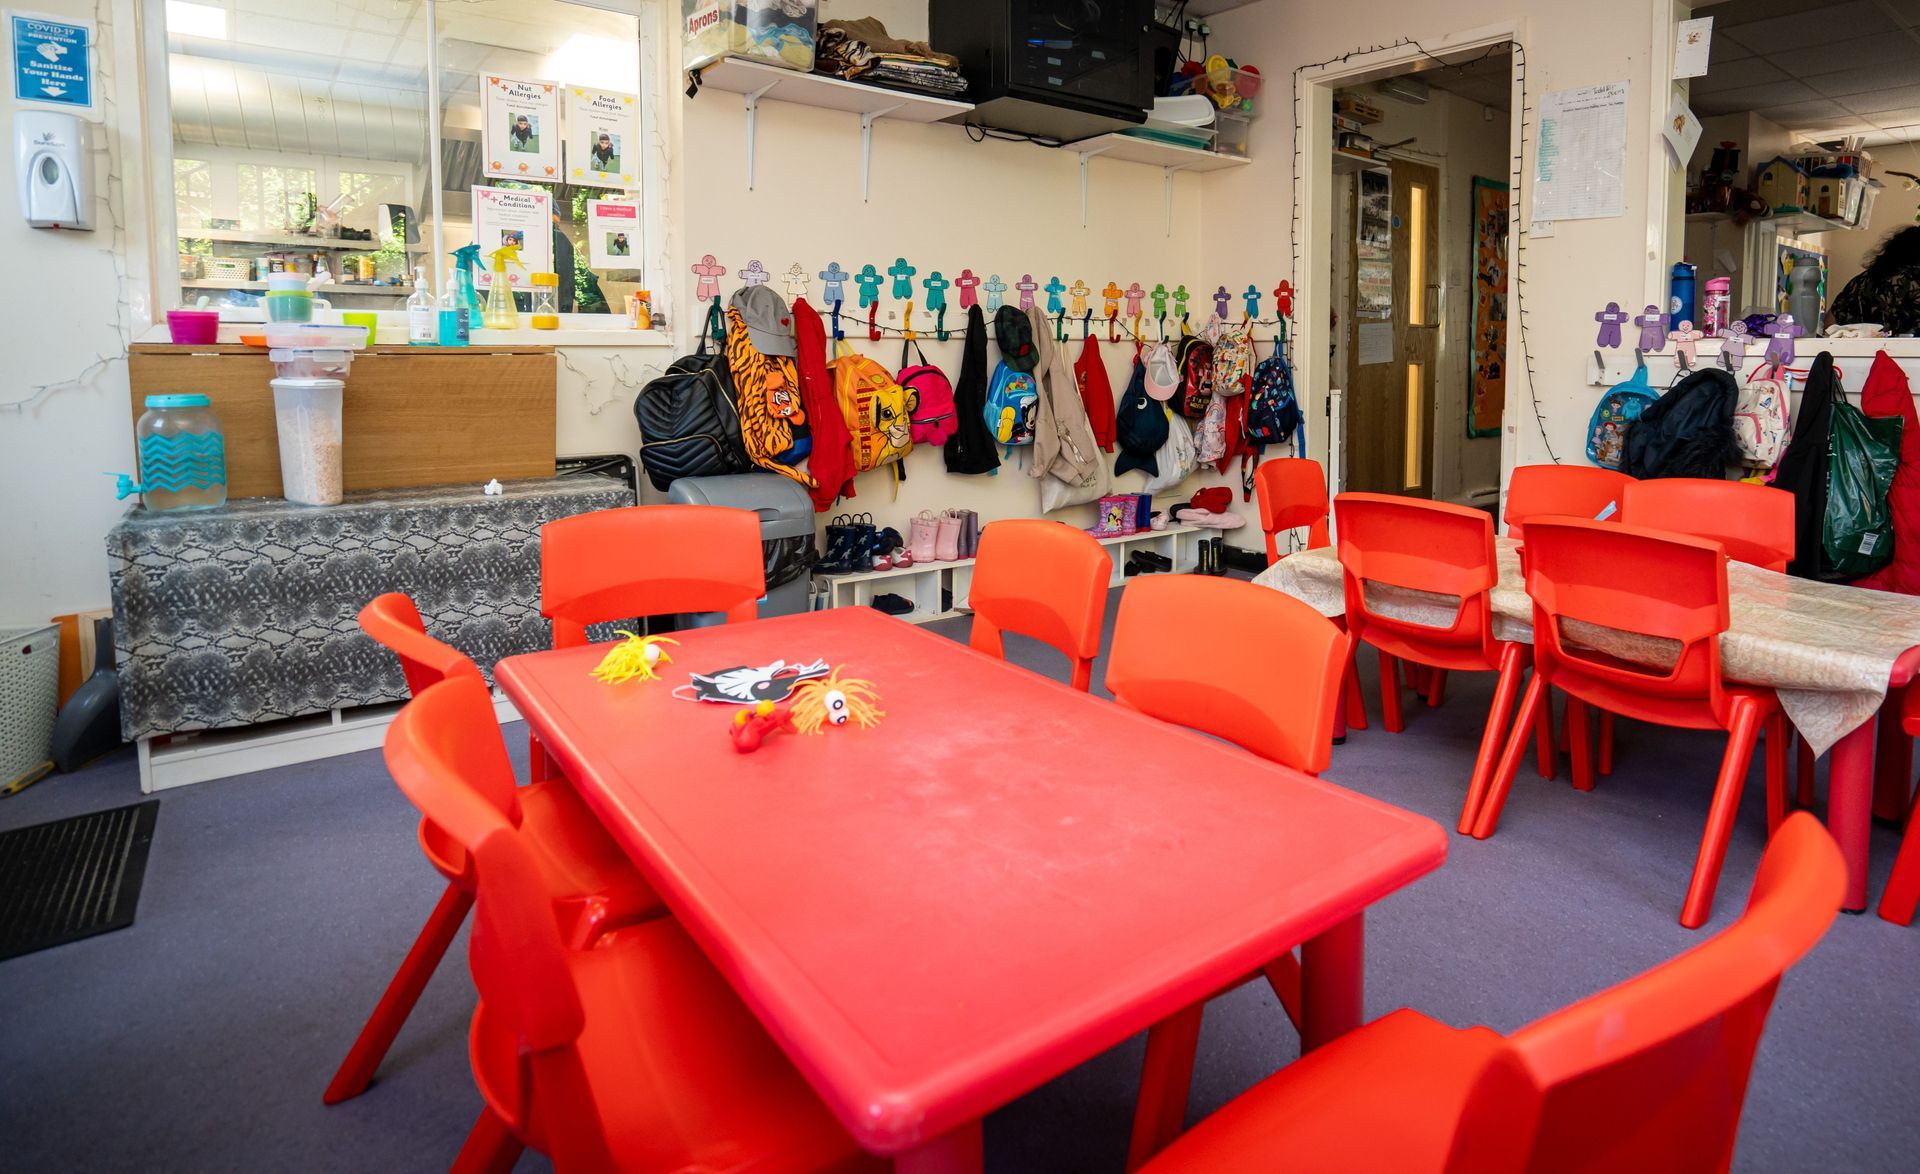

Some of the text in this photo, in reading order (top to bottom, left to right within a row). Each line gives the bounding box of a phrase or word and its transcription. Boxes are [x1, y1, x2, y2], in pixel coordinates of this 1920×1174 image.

[688, 9, 718, 35] Aprons
[27, 22, 75, 36] COVID-19
[28, 32, 77, 44] PREVENTION
[29, 60, 74, 72] Sanitize
[22, 67, 84, 82] Your Hands
[41, 78, 67, 87] Here
[517, 83, 532, 92] Nut
[508, 89, 542, 100] Allergies
[599, 94, 616, 103] Food
[592, 100, 622, 111] Allergies
[503, 194, 531, 203] Medical
[498, 200, 536, 209] Conditions
